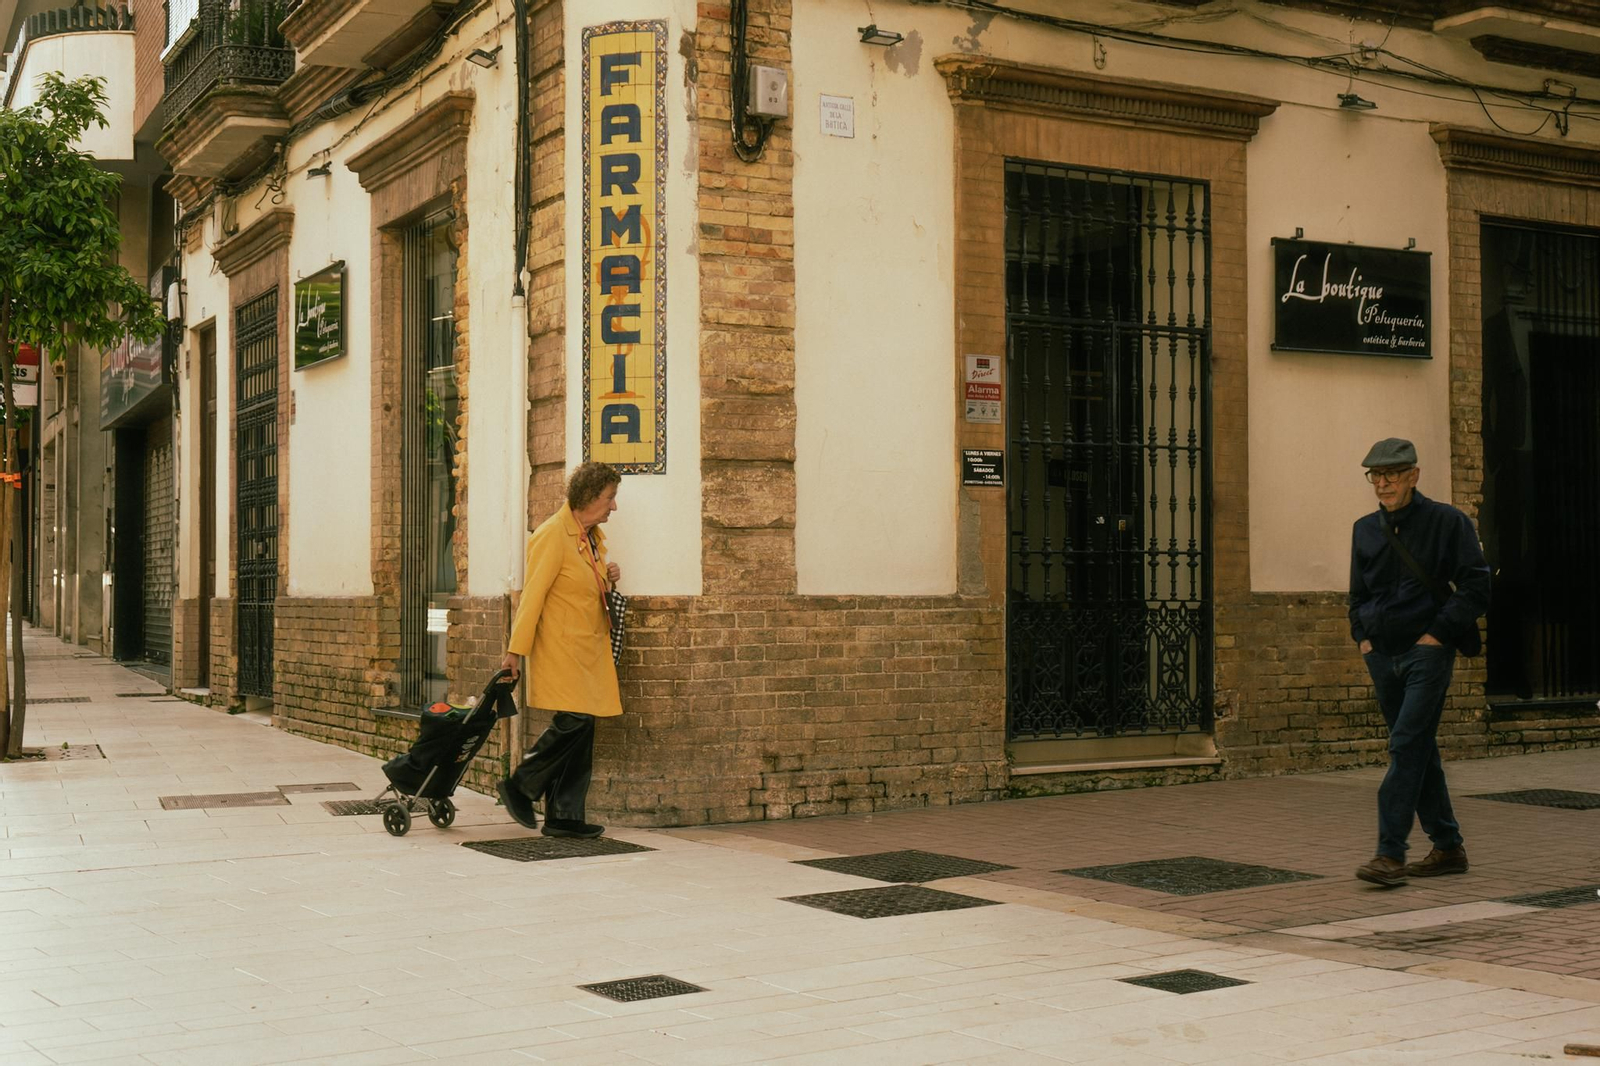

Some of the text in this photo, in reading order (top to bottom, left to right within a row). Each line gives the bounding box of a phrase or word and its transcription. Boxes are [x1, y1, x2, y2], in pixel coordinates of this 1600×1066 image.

[600, 52, 642, 444] FARMACIA
[1282, 253, 1383, 325] La boutique
[1364, 304, 1425, 331] Peluquería,
[1363, 335, 1425, 348] estética & barbería
[968, 384, 1000, 395] Alarma
